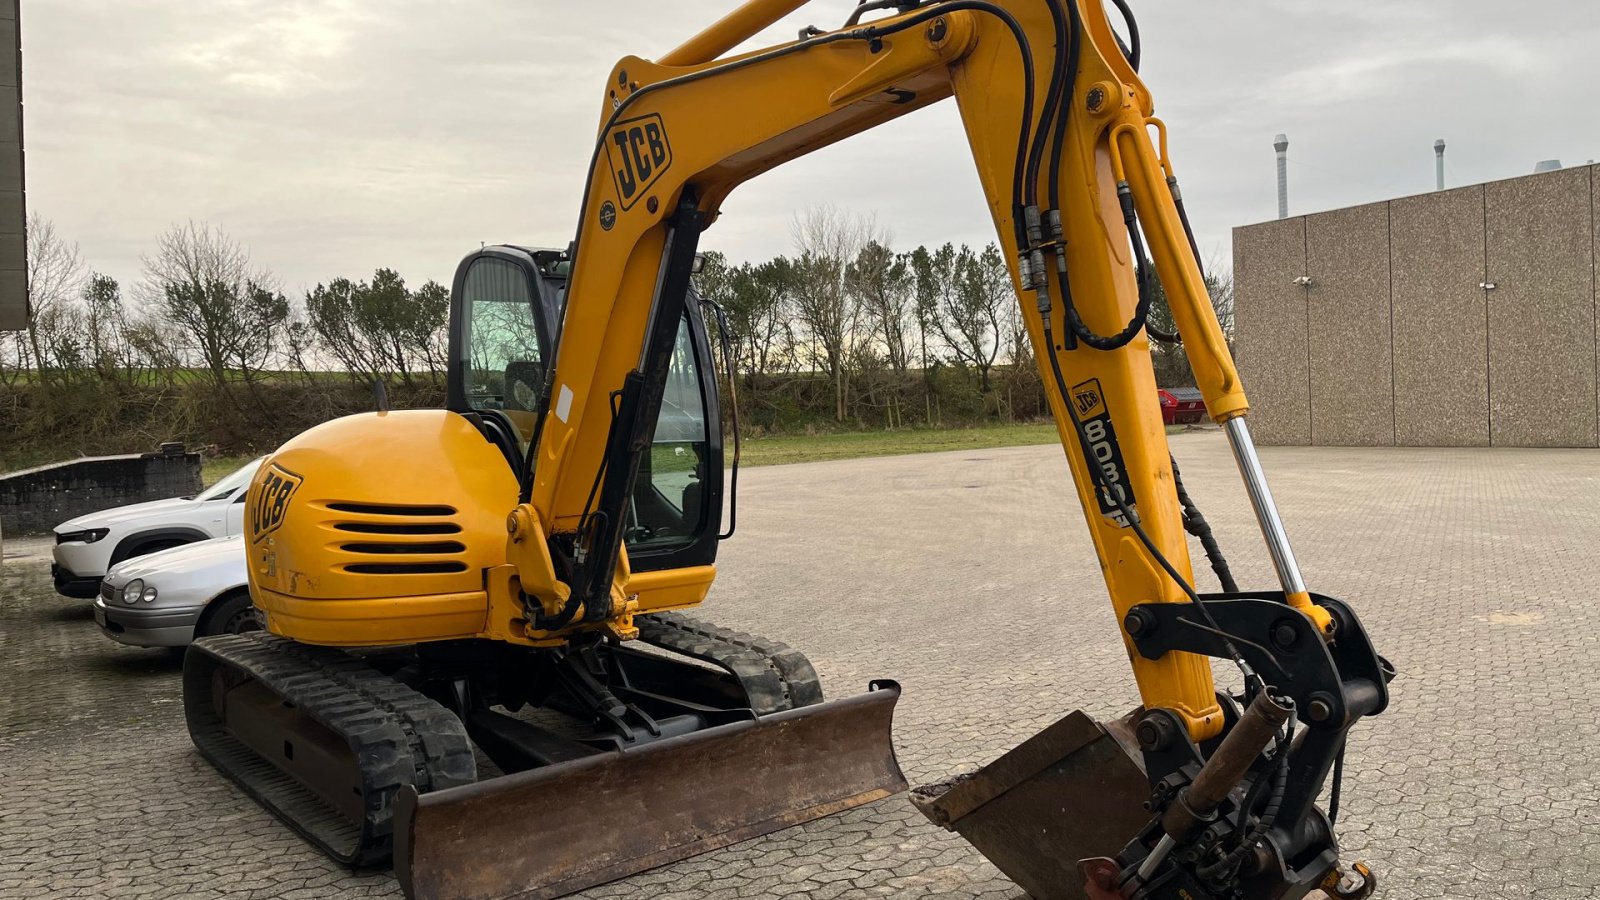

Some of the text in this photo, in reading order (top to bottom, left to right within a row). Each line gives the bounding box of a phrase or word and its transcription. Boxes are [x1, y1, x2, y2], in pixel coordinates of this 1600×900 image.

[614, 123, 665, 199] JCB
[1076, 392, 1098, 412] JCB
[254, 472, 293, 535] JCB
